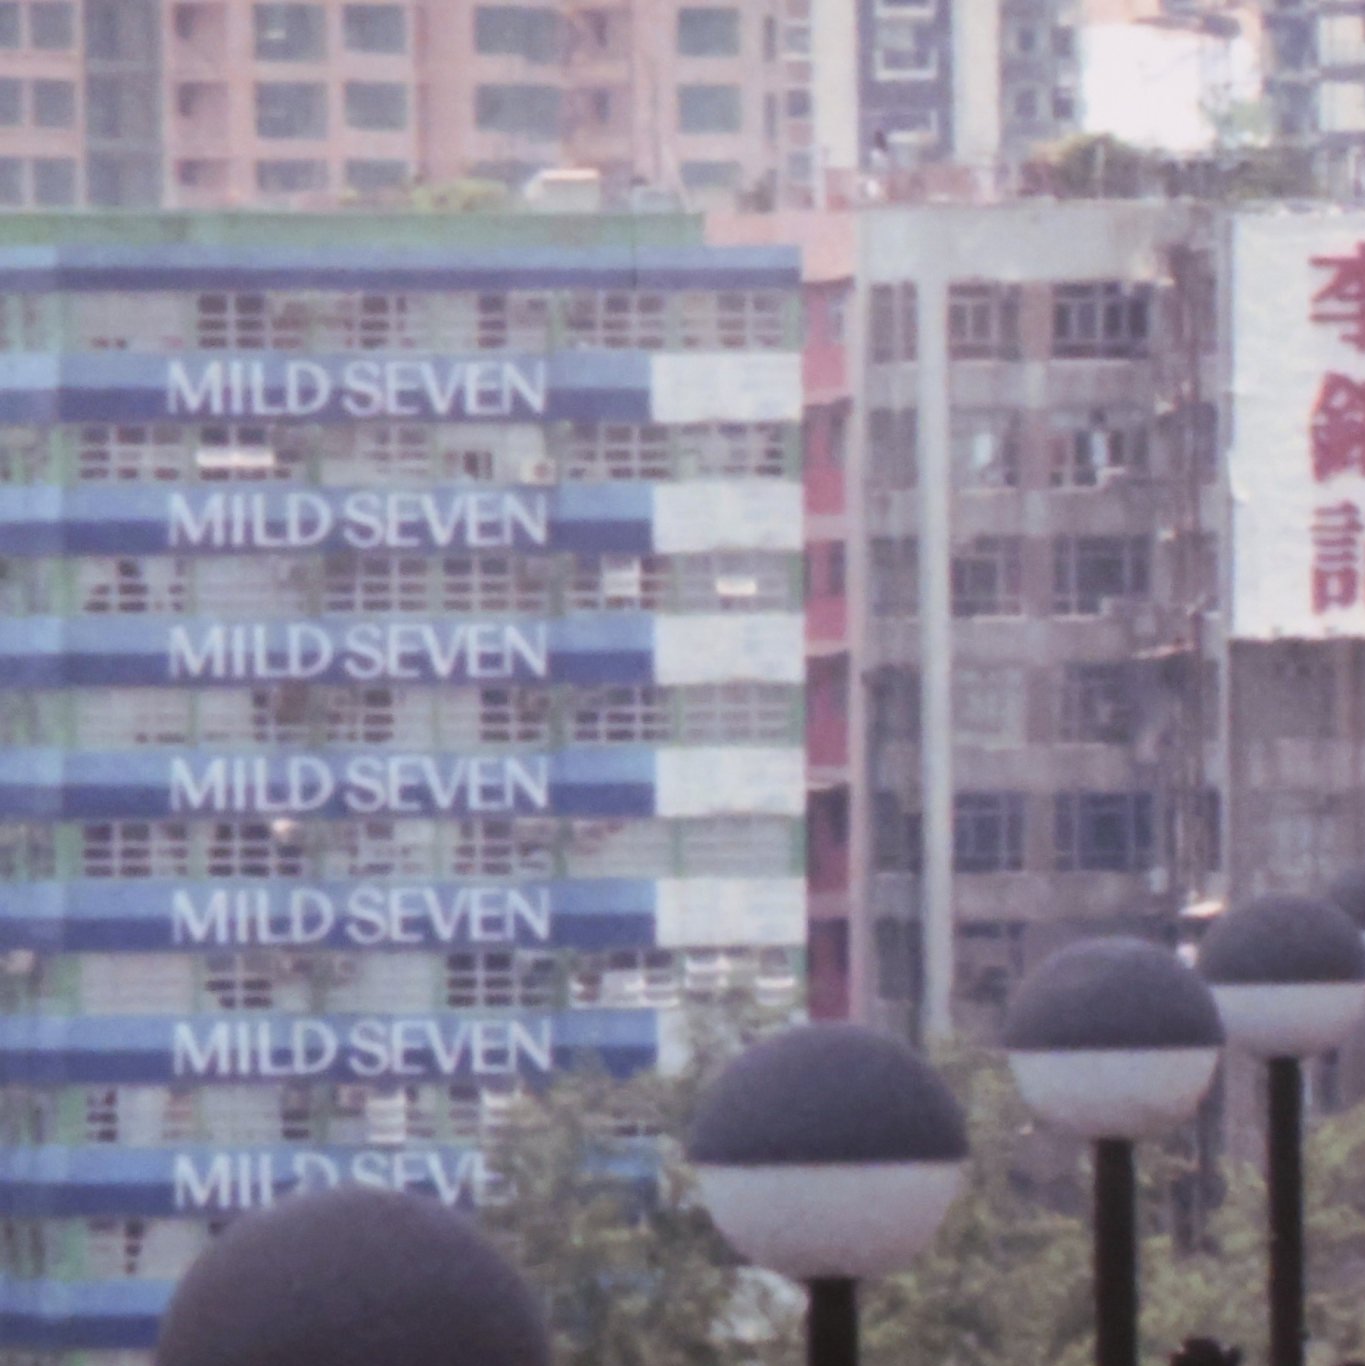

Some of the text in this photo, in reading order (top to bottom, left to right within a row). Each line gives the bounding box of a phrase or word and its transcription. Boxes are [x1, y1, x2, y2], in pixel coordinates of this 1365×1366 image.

[166, 361, 547, 414] MILD SEVEN
[167, 493, 549, 547] MILD SEVEN
[168, 625, 550, 679] MILD SEVEN
[169, 757, 550, 812] MILD SEVEN
[171, 889, 551, 944] MILD SEVEN
[173, 1021, 553, 1076] MILD SEVEN
[350, 1151, 517, 1206] SEVE
